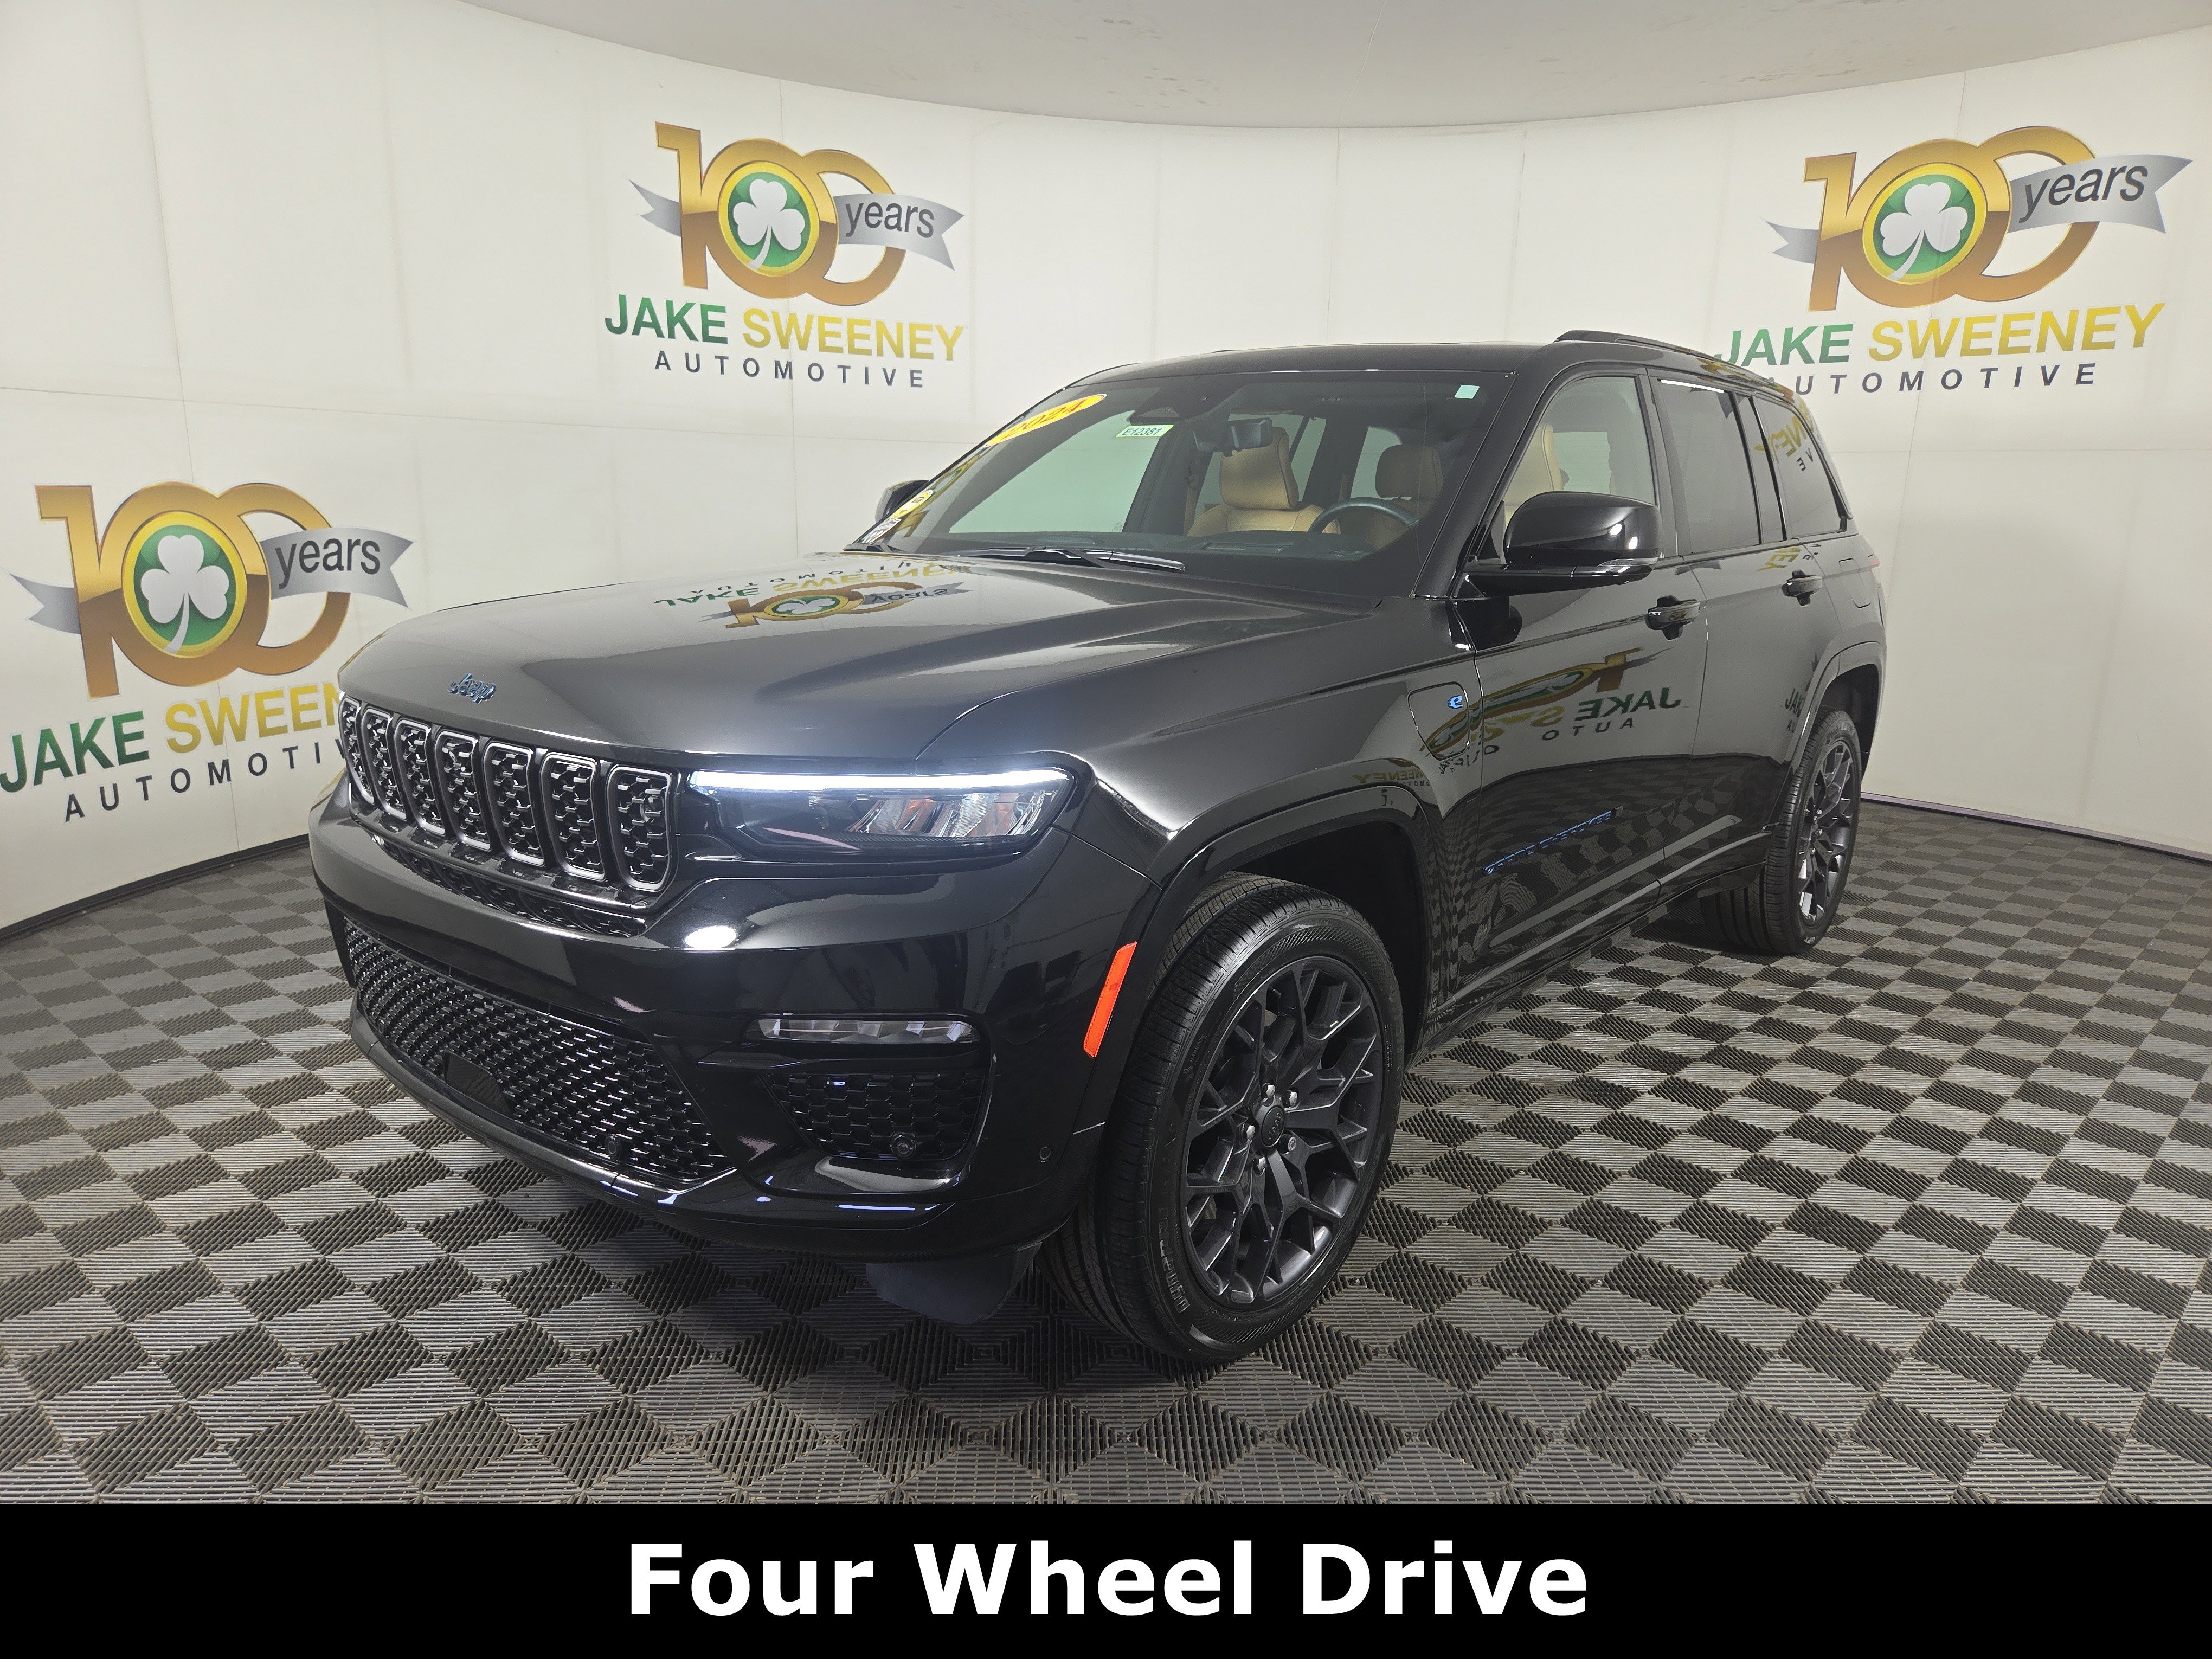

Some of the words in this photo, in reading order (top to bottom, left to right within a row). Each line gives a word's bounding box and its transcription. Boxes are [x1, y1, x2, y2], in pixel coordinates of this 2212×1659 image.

[655, 121, 907, 306] 100
[845, 201, 935, 238] years
[1803, 125, 2101, 312] 100
[2018, 164, 2149, 223] years
[605, 293, 728, 344] JAKE
[742, 308, 965, 362] SWEENEY
[1714, 323, 1854, 367] JAKE
[1868, 303, 2168, 363] SWEENEY
[654, 350, 923, 388] AUTOMOTIVE
[1768, 362, 2097, 396] UTOMOTIVE
[35, 481, 351, 699] 100
[275, 537, 381, 590] years
[447, 673, 497, 704] Jeep
[0, 710, 150, 793] JAKE
